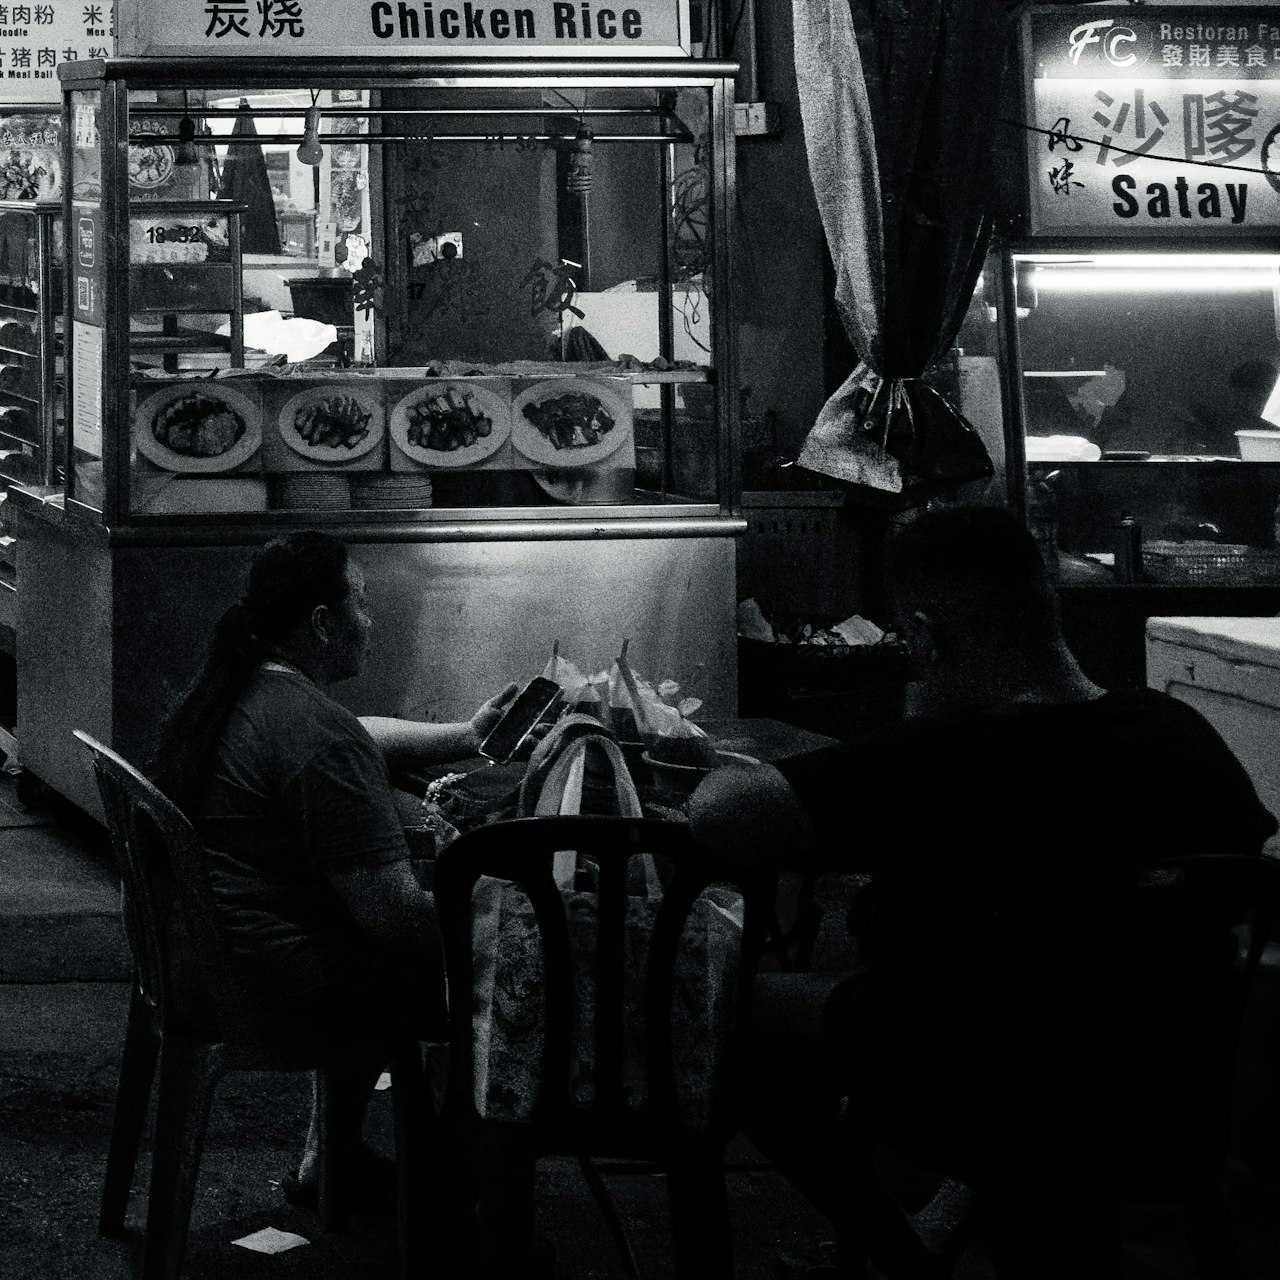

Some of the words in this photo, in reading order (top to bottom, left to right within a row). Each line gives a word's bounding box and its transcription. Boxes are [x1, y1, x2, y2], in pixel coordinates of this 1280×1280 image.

[370, 1, 541, 39] Chicken
[554, 1, 642, 39] Rice
[1160, 23, 1248, 40] Restoran
[35, 71, 52, 79] Ball
[1112, 174, 1248, 224] Satay
